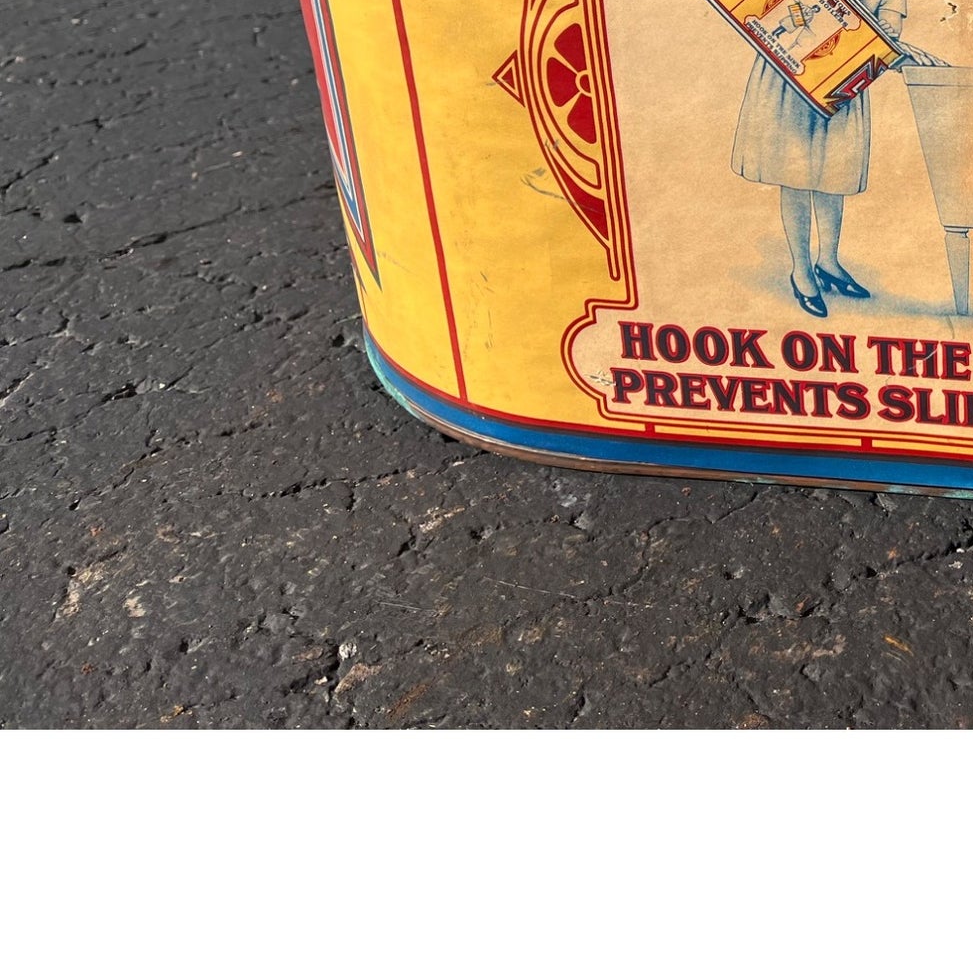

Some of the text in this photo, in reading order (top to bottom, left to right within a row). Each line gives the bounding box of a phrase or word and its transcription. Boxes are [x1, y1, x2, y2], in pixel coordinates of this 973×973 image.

[619, 320, 774, 371] HOOK
[782, 330, 861, 375] ON
[867, 335, 972, 381] THE
[609, 367, 870, 420] PREVENTS
